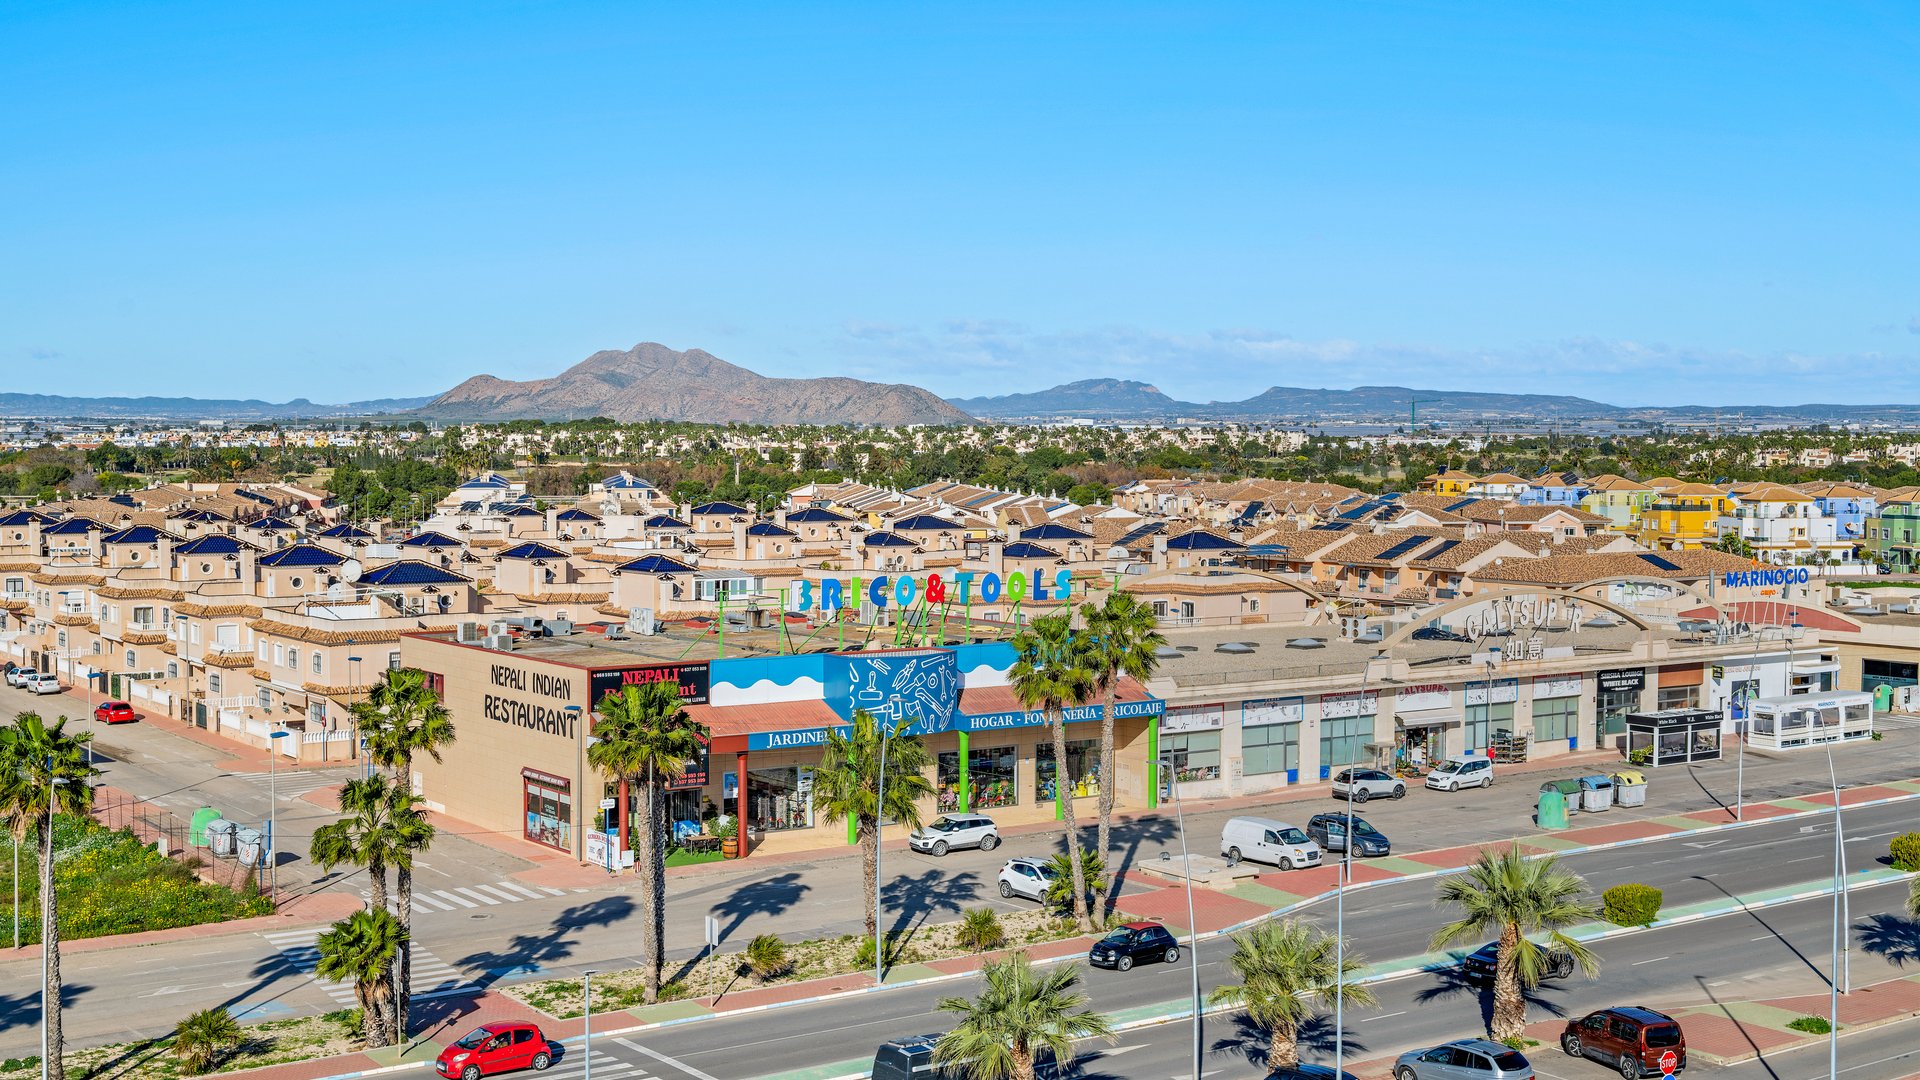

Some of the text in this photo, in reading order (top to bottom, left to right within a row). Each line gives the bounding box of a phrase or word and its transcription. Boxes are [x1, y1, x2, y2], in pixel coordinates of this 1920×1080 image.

[1726, 567, 1809, 588] MARINOCIO
[1506, 635, 1543, 661] 如意
[491, 664, 571, 700] NEPALI INDIAN
[622, 668, 680, 685] NEPALI
[484, 694, 577, 739] RESTAURANT
[971, 715, 1014, 729] HOGAR
[1108, 702, 1162, 717] RICOLAJE
[1661, 1057, 1676, 1069] STOP
